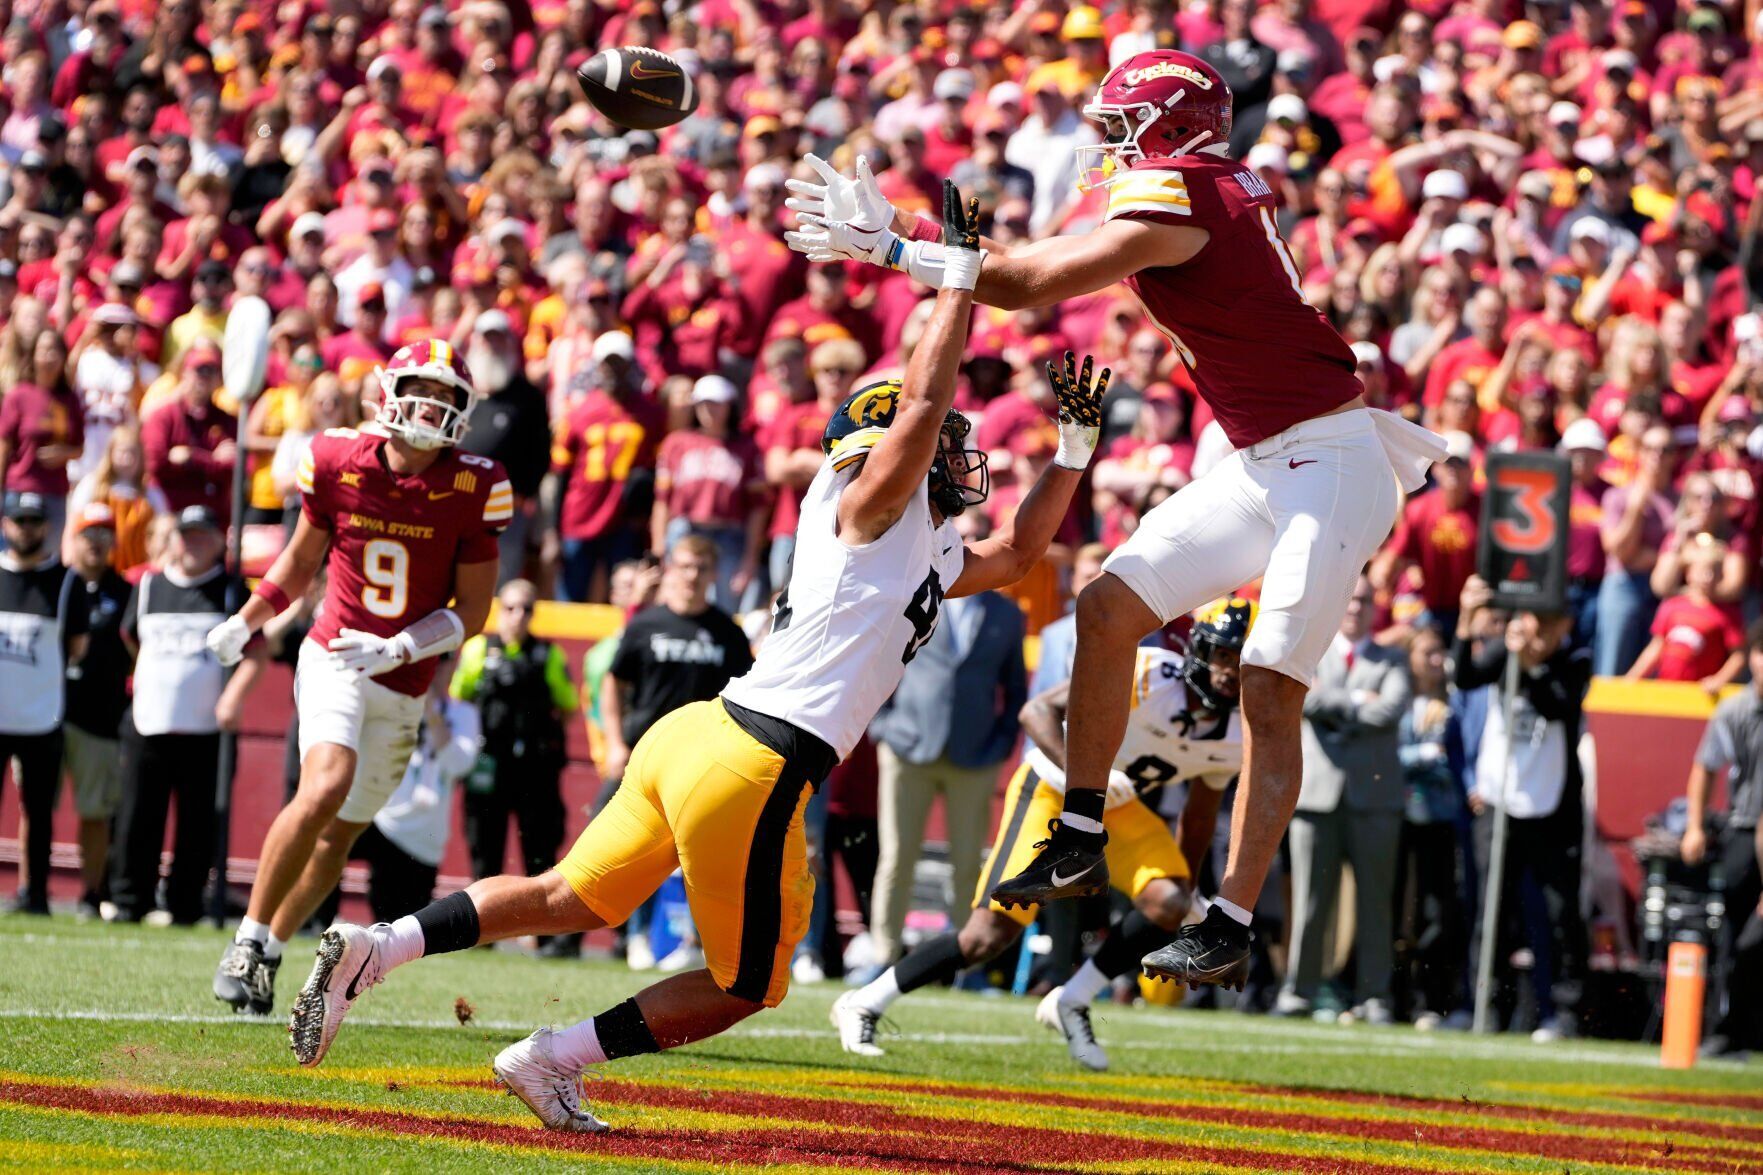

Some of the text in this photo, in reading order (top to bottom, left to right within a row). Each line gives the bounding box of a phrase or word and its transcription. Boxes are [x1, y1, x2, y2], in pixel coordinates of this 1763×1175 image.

[1125, 61, 1213, 91] Cyclones
[1259, 205, 1308, 305] 1
[459, 453, 494, 470] 9
[584, 421, 644, 482] 17
[349, 513, 434, 539] IOWA STATE
[1491, 468, 1557, 554] 3
[361, 537, 409, 618] 9
